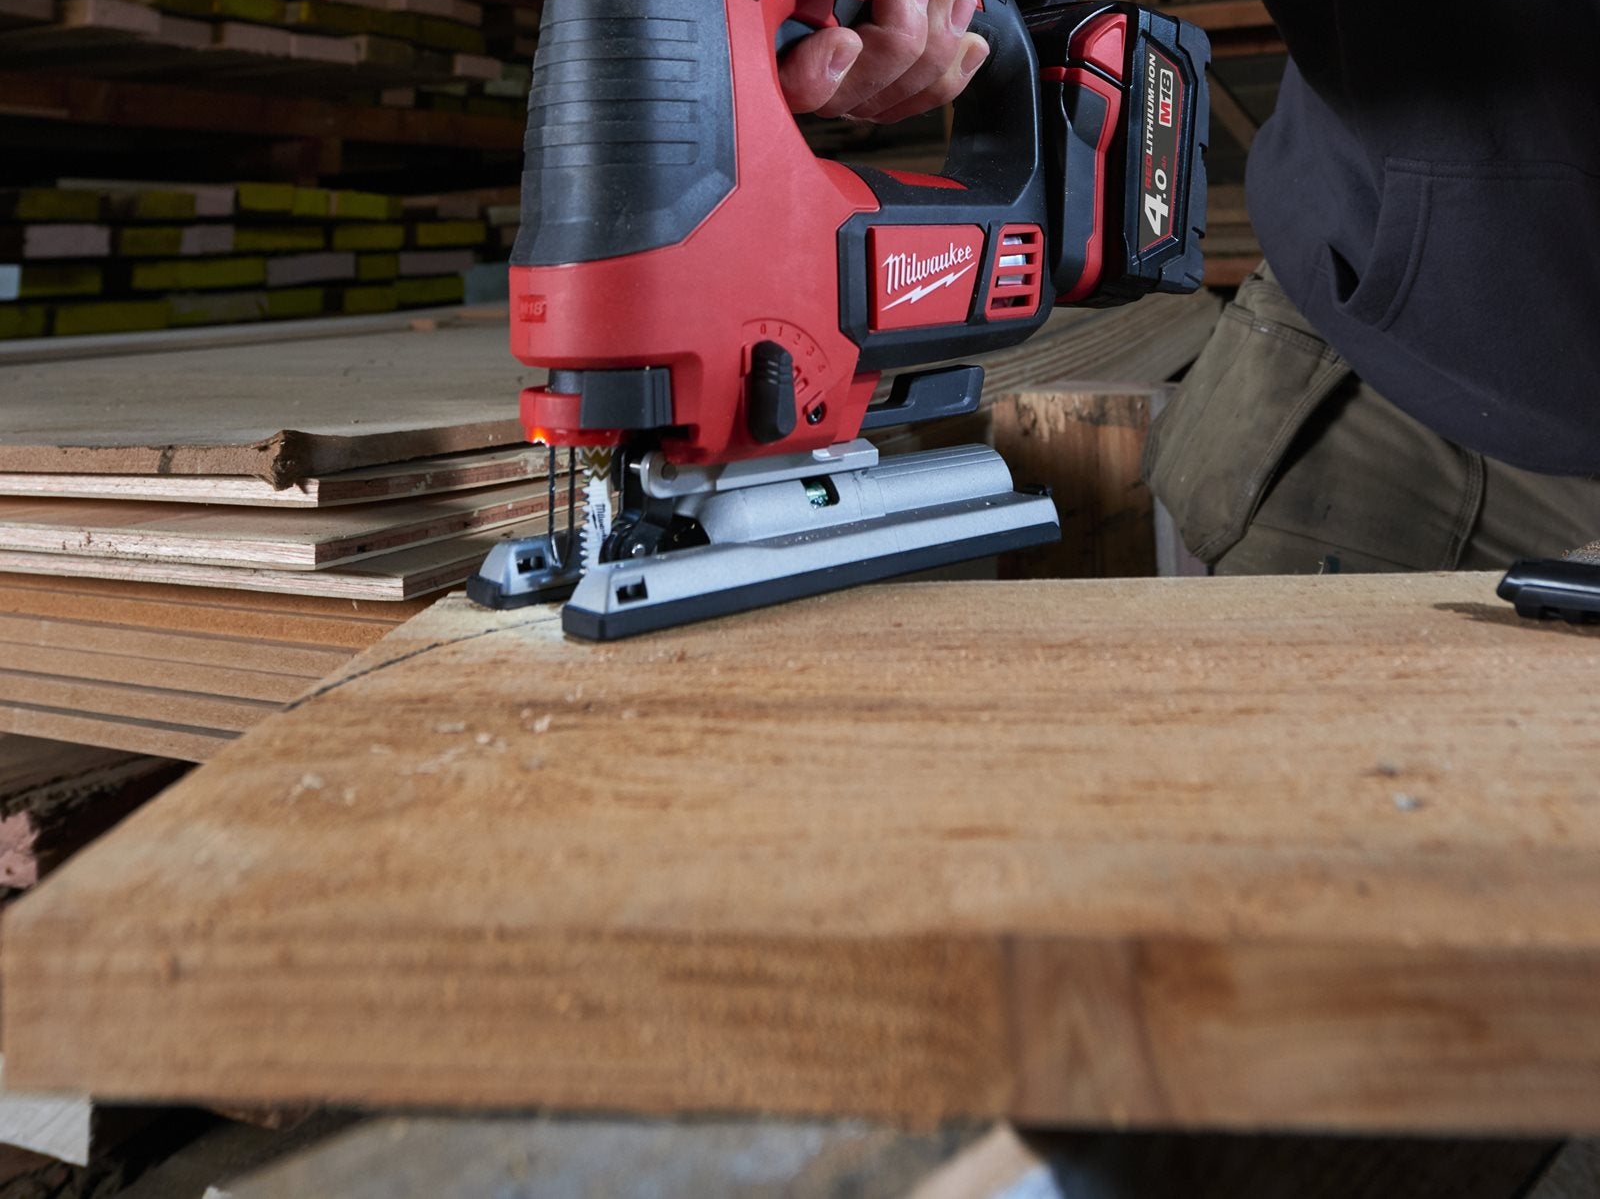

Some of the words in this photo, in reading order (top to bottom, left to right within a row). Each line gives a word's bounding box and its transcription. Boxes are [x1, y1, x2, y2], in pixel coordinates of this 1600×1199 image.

[1160, 71, 1172, 124] M18
[1144, 168, 1169, 237] 4.0
[881, 242, 974, 295] Milwaukee
